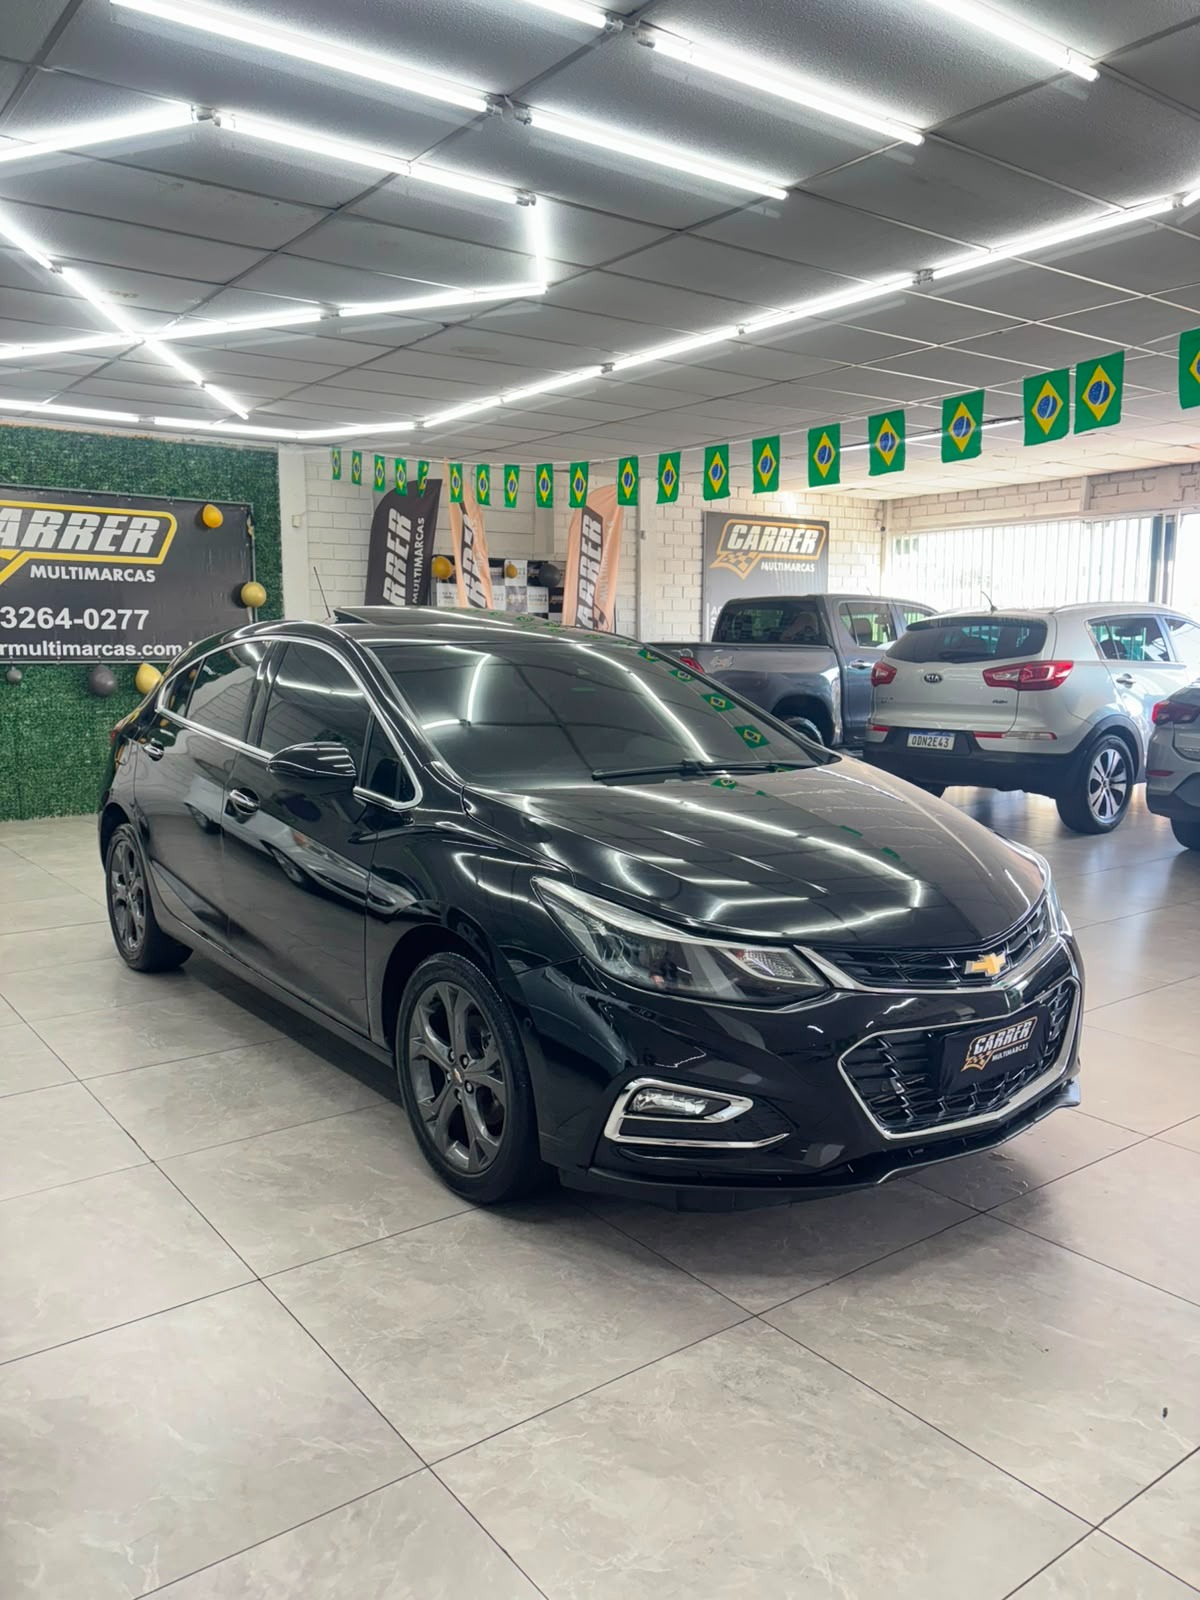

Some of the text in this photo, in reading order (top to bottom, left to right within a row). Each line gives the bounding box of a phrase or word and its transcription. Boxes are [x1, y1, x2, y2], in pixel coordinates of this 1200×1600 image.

[727, 524, 820, 554] CARRER
[30, 564, 156, 583] MULTIMARCAS
[412, 517, 425, 604] MULTIMARCAS
[576, 513, 602, 630] ARRER
[761, 561, 816, 573] MULTIMARCAS
[0, 605, 150, 631] 3264-0277
[0, 640, 192, 657] rmultimarcas.com
[973, 1020, 1033, 1056] CARRER
